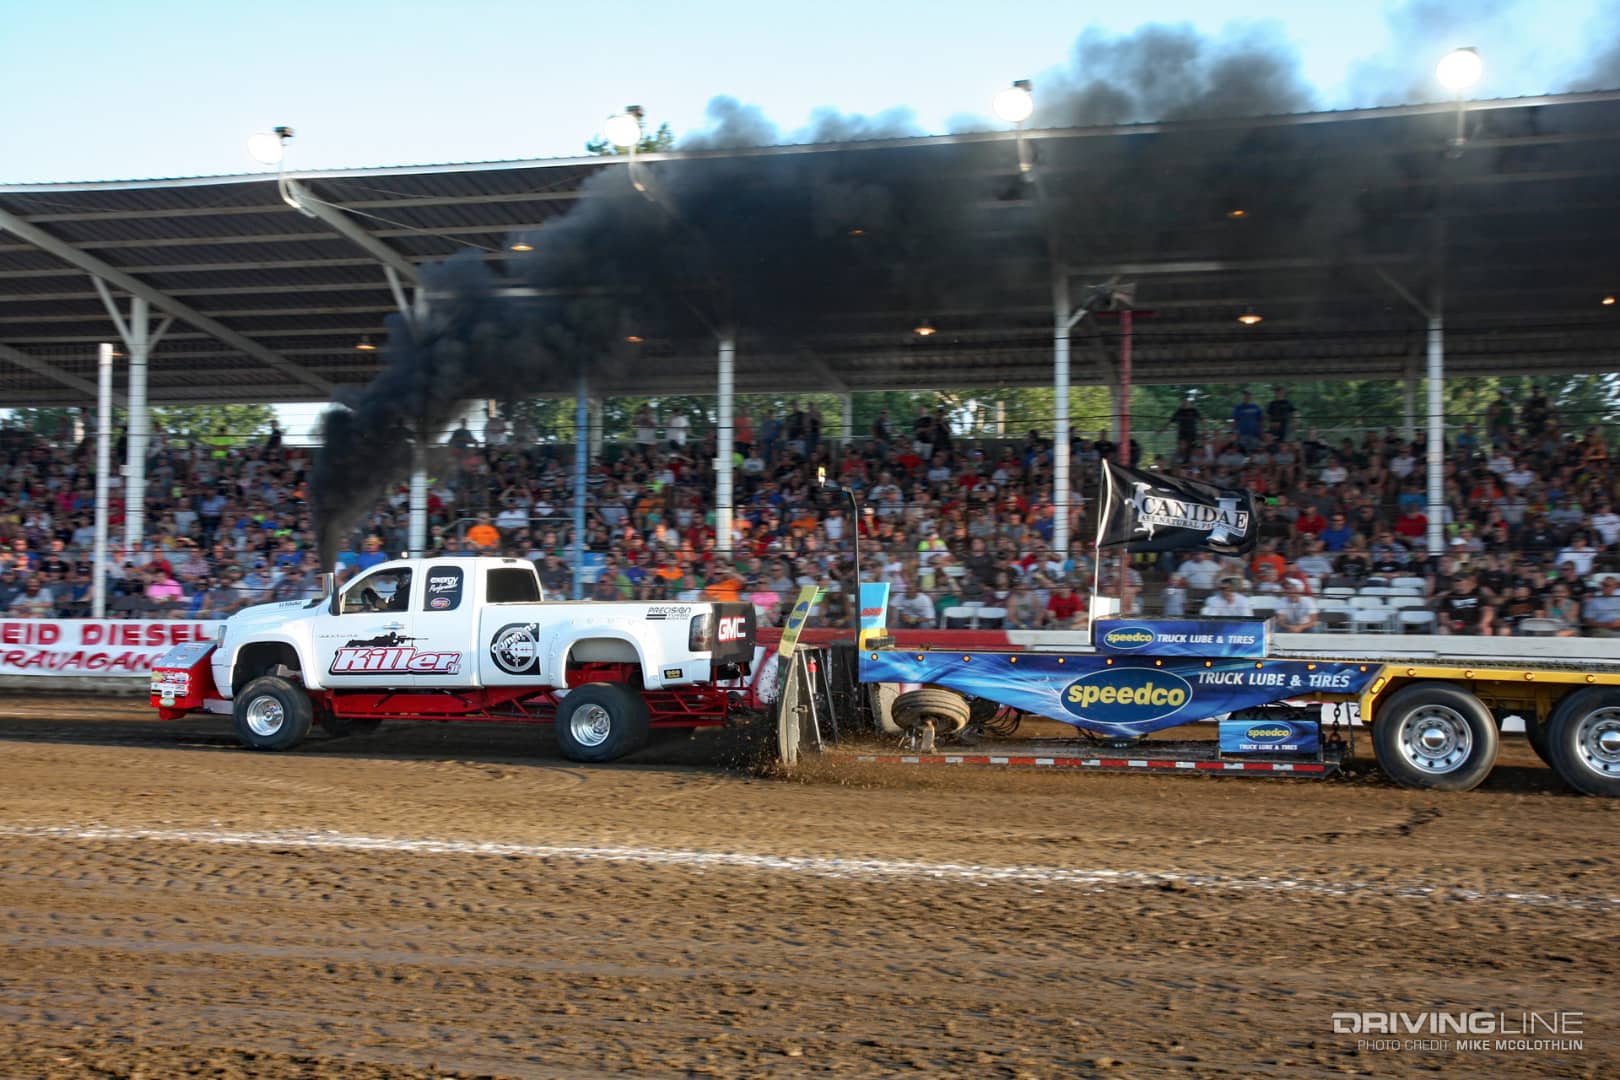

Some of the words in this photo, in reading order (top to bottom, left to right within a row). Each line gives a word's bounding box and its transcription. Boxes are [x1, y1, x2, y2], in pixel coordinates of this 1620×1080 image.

[1142, 497, 1247, 529] CANIDAE
[648, 606, 692, 614] PRECISION
[81, 623, 211, 646] DIESEL
[718, 616, 746, 642] GMC
[1107, 632, 1152, 643] speedco
[1157, 634, 1187, 643] TRUCK
[1189, 634, 1213, 643] LUBE
[1216, 635, 1224, 643] &
[1228, 635, 1255, 644] TIRES
[332, 648, 462, 673] Killer
[1199, 671, 1244, 685] TRUCK
[1248, 672, 1286, 686] LUBE
[1290, 674, 1301, 687] &
[1308, 674, 1350, 688] TIRES
[1068, 682, 1185, 708] speedco
[1248, 728, 1290, 738] speedco
